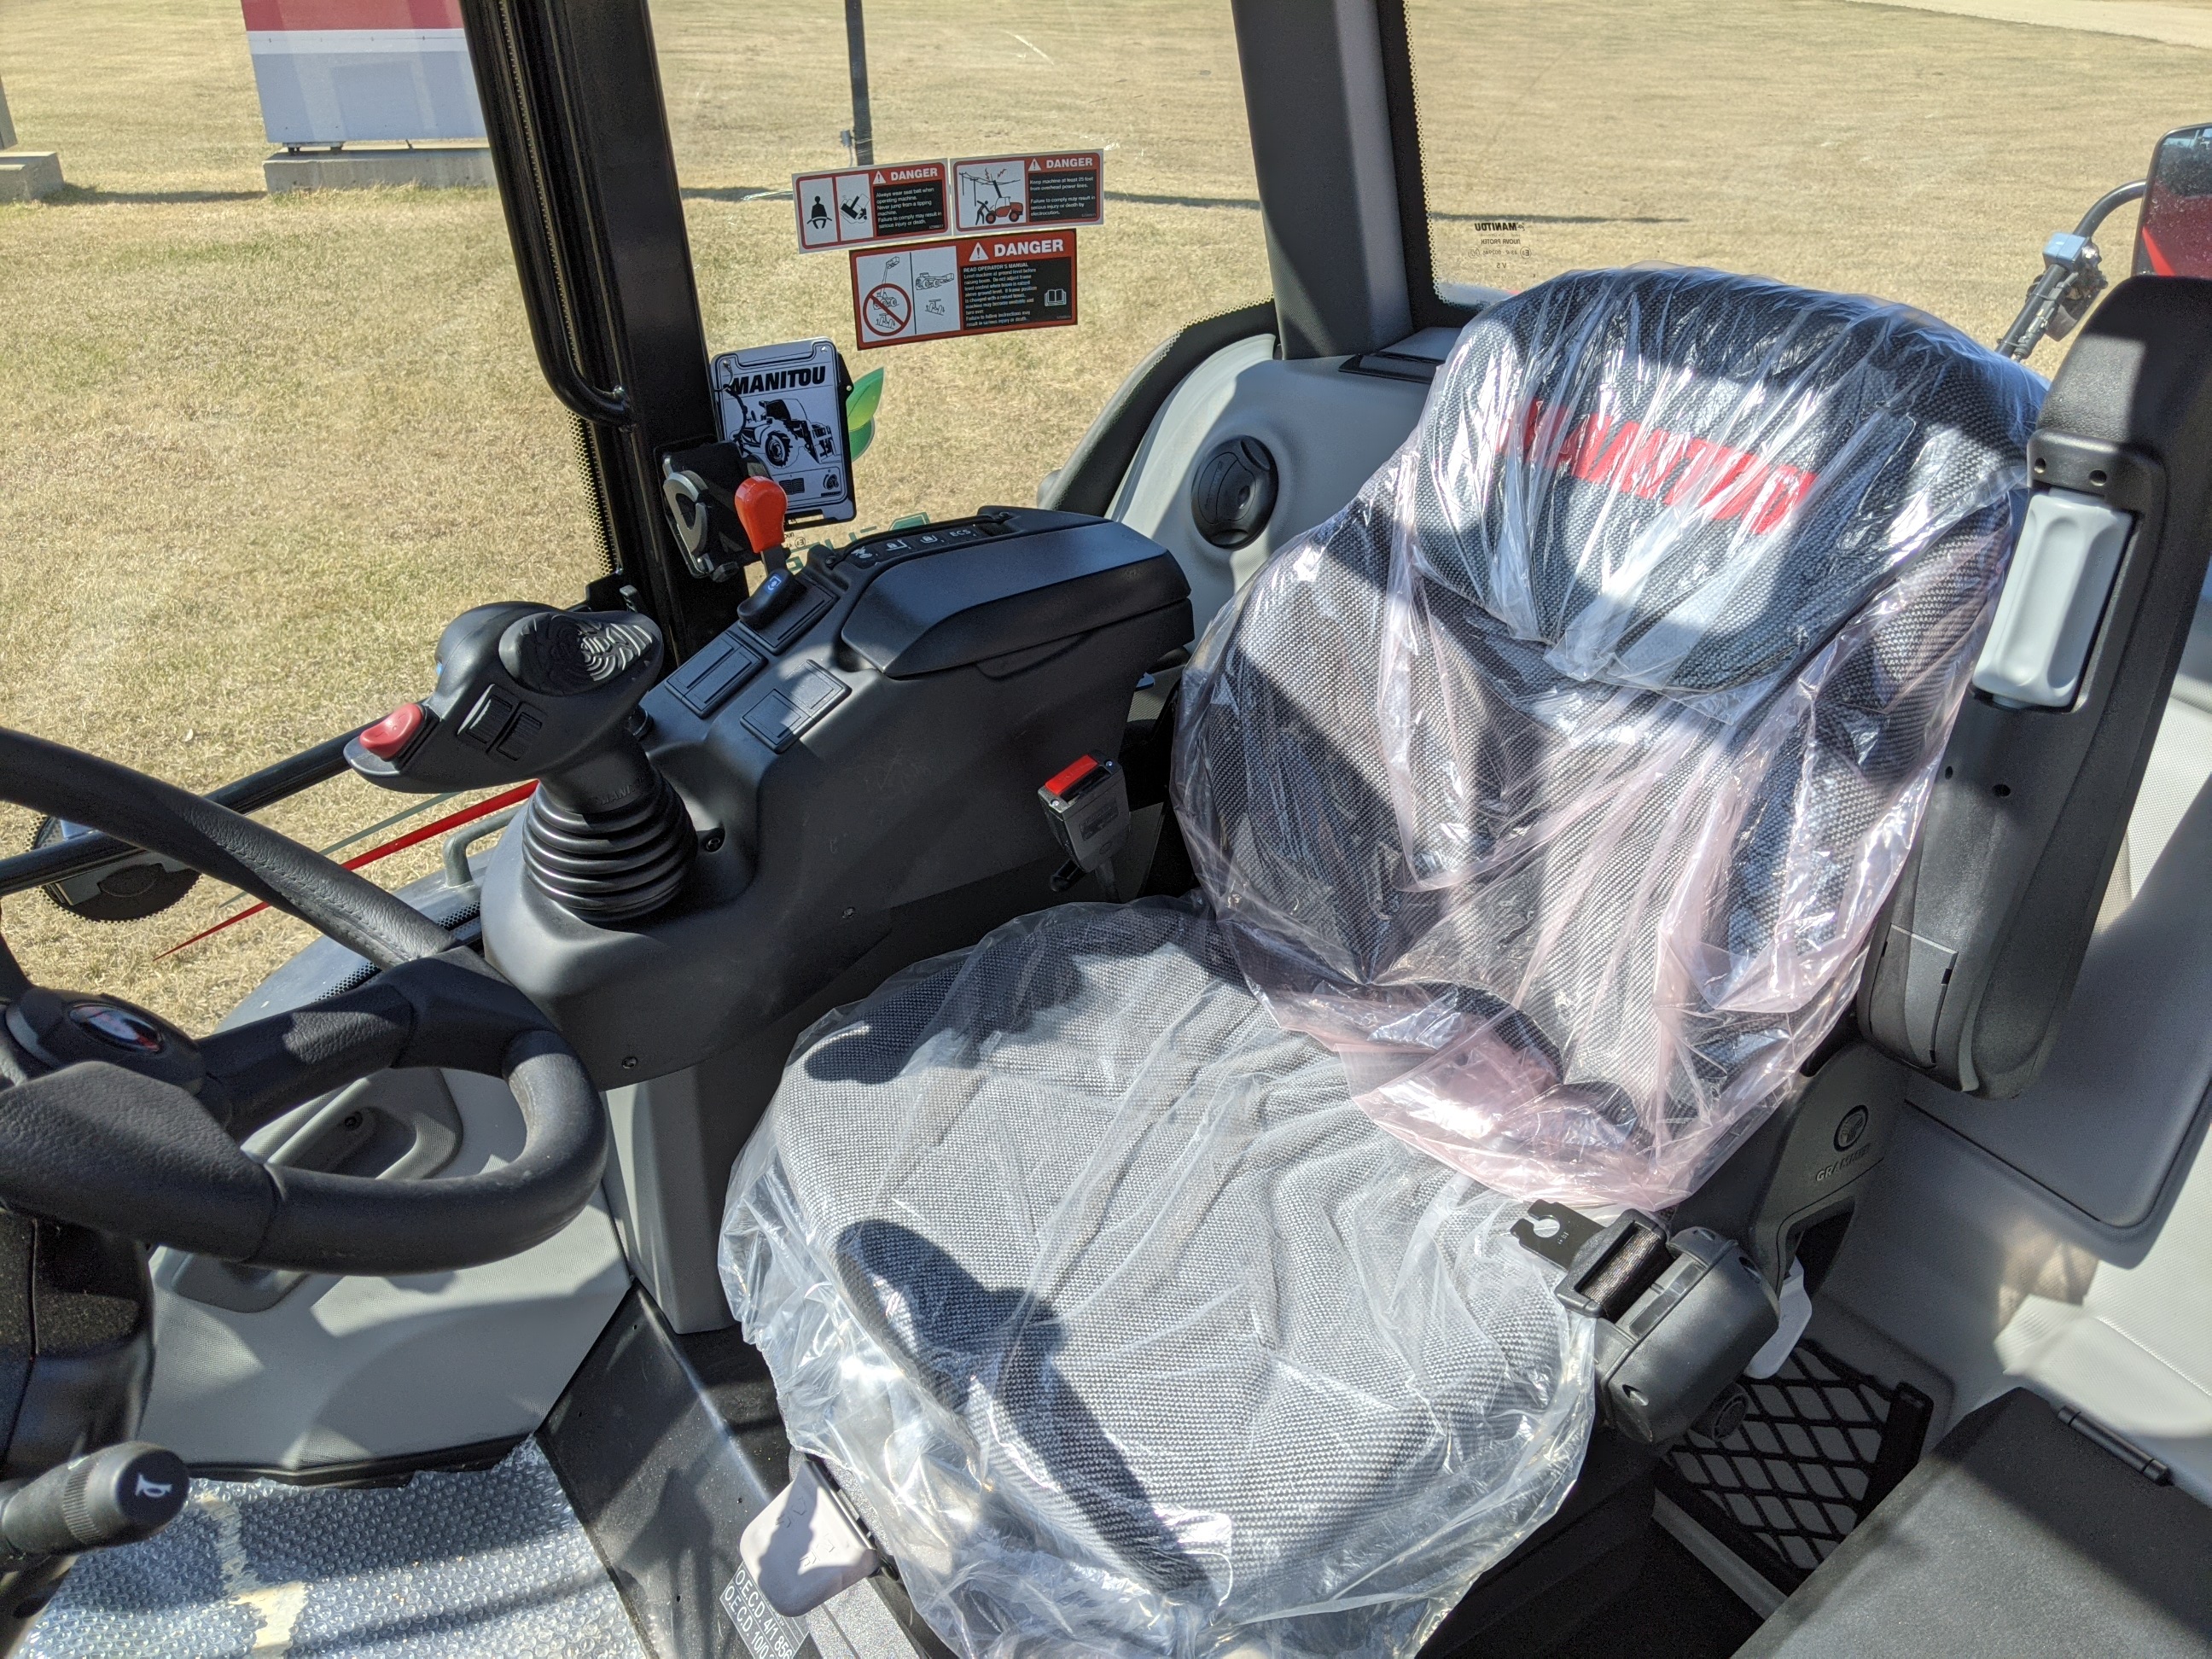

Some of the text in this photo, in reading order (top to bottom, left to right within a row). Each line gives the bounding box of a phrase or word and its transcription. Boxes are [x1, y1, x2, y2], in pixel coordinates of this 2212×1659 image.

[1046, 158, 1092, 168] DANGER
[891, 168, 938, 181] DANGER
[994, 238, 1063, 256] DANGER
[732, 365, 826, 395] MANITOU
[949, 528, 971, 538] ECS
[725, 1586, 753, 1637] O.E.C.D.
[735, 1569, 765, 1623] O.E.C.D.
[763, 1618, 778, 1641] 4/1
